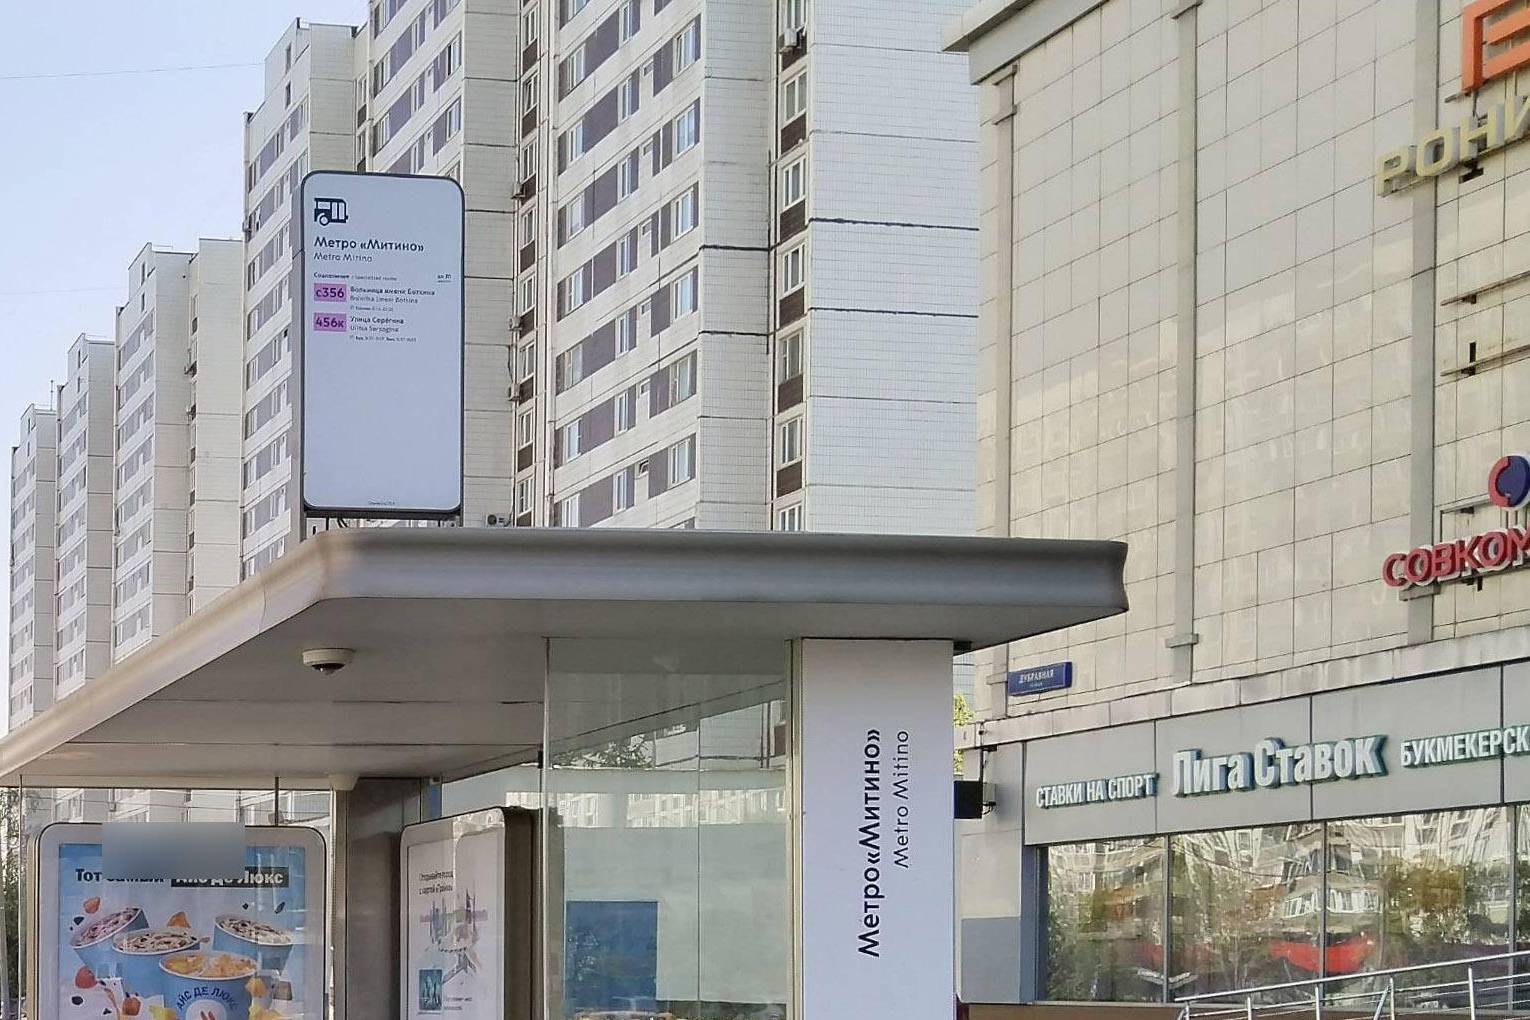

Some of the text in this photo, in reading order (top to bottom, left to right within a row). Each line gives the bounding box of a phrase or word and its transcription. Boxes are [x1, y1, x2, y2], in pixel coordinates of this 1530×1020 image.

[314, 237, 424, 252] Метро «Митино»
[1400, 725, 1530, 767] БУКМЕКЕРСК
[1173, 735, 1388, 798] Лига Ставок
[893, 730, 909, 869] Metro Mitino
[1035, 773, 1158, 809] СТАВКИ НА СПОРТ
[75, 868, 102, 882] Тот
